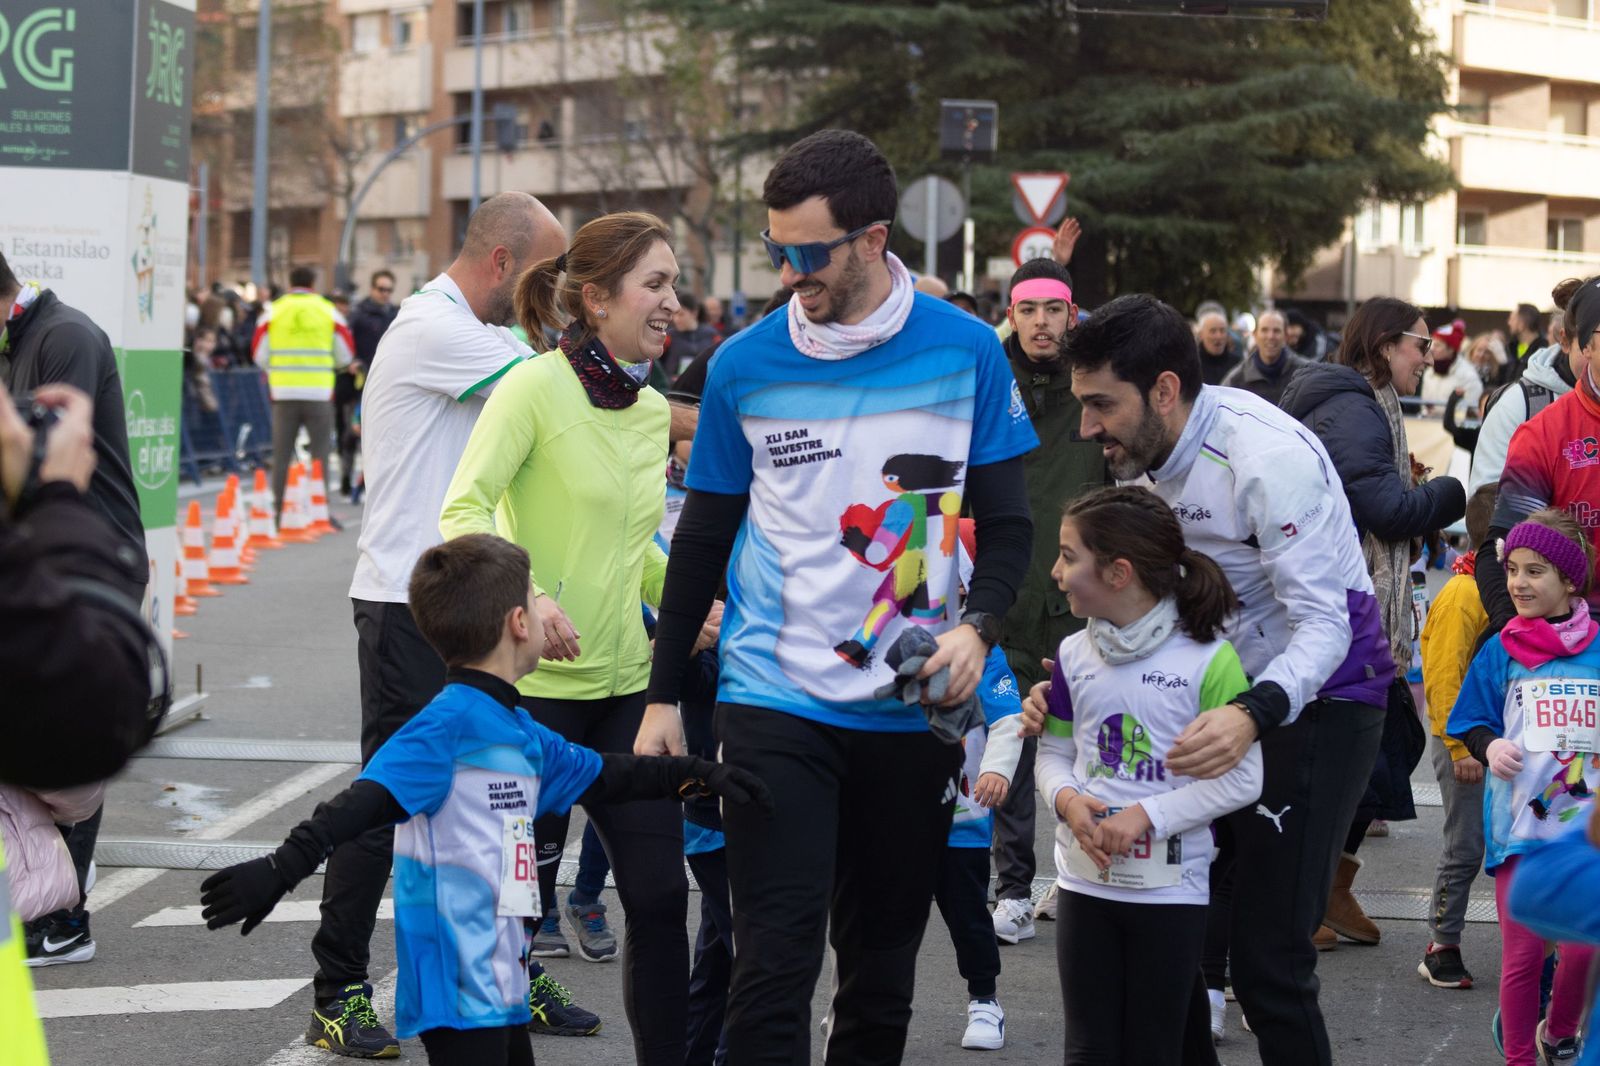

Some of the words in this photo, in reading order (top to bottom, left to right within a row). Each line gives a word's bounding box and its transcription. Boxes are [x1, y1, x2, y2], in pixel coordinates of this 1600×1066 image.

[0, 8, 75, 91] G
[11, 110, 72, 121] SOLUCIONES
[33, 124, 71, 134] MEDIDA
[12, 238, 110, 260] Estanislao
[8, 260, 64, 280] ostka
[765, 433, 782, 445] XLI
[784, 428, 808, 440] SAN
[768, 439, 823, 456] SILVESTRE
[772, 448, 842, 468] SALMANTINA
[1549, 684, 1600, 697] SETE
[1536, 698, 1596, 728] 6846
